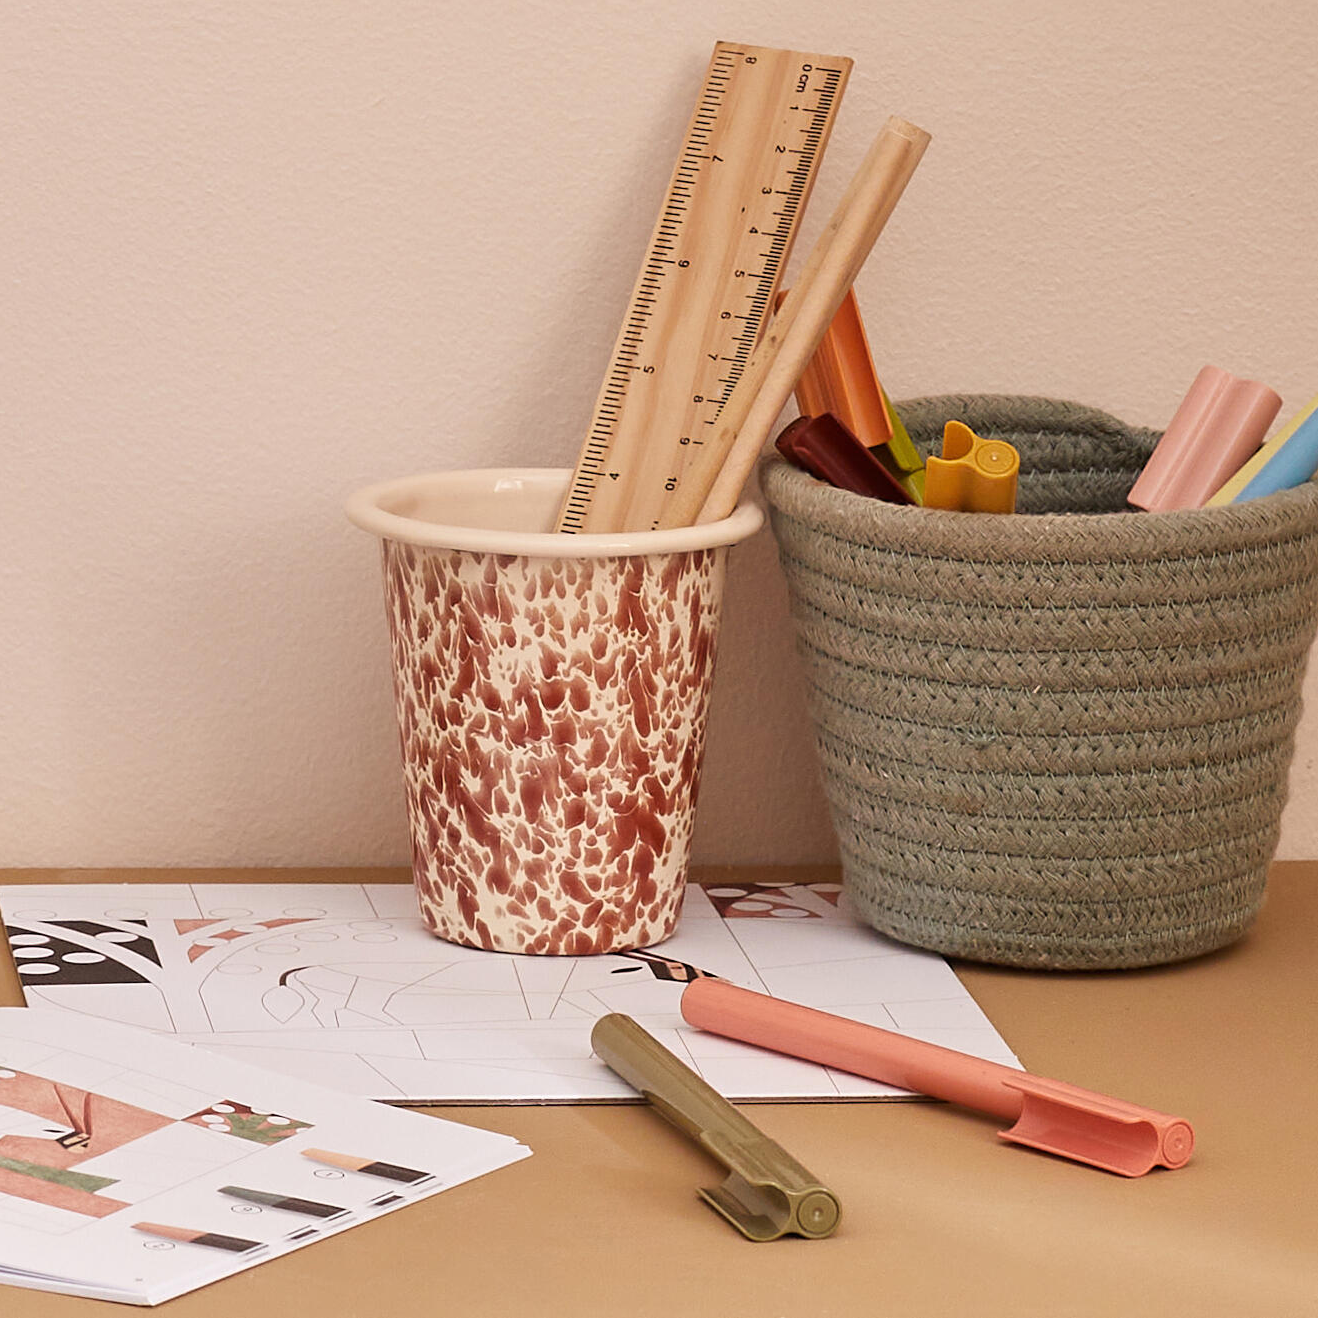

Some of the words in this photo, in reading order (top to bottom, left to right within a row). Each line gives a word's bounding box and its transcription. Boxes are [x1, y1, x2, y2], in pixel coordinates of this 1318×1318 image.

[795, 74, 809, 93] cm
[775, 145, 786, 154] 2
[762, 187, 772, 195] 3
[749, 226, 759, 234] 4
[609, 472, 620, 481] 4
[643, 366, 655, 374] 5
[678, 259, 690, 268] 6
[712, 155, 724, 163] 7
[745, 57, 757, 65] 8
[734, 269, 745, 278] 5
[721, 311, 731, 320] 6
[708, 353, 718, 361] 7
[693, 395, 704, 403] 8
[680, 437, 690, 445] 9
[665, 477, 677, 491] 10
